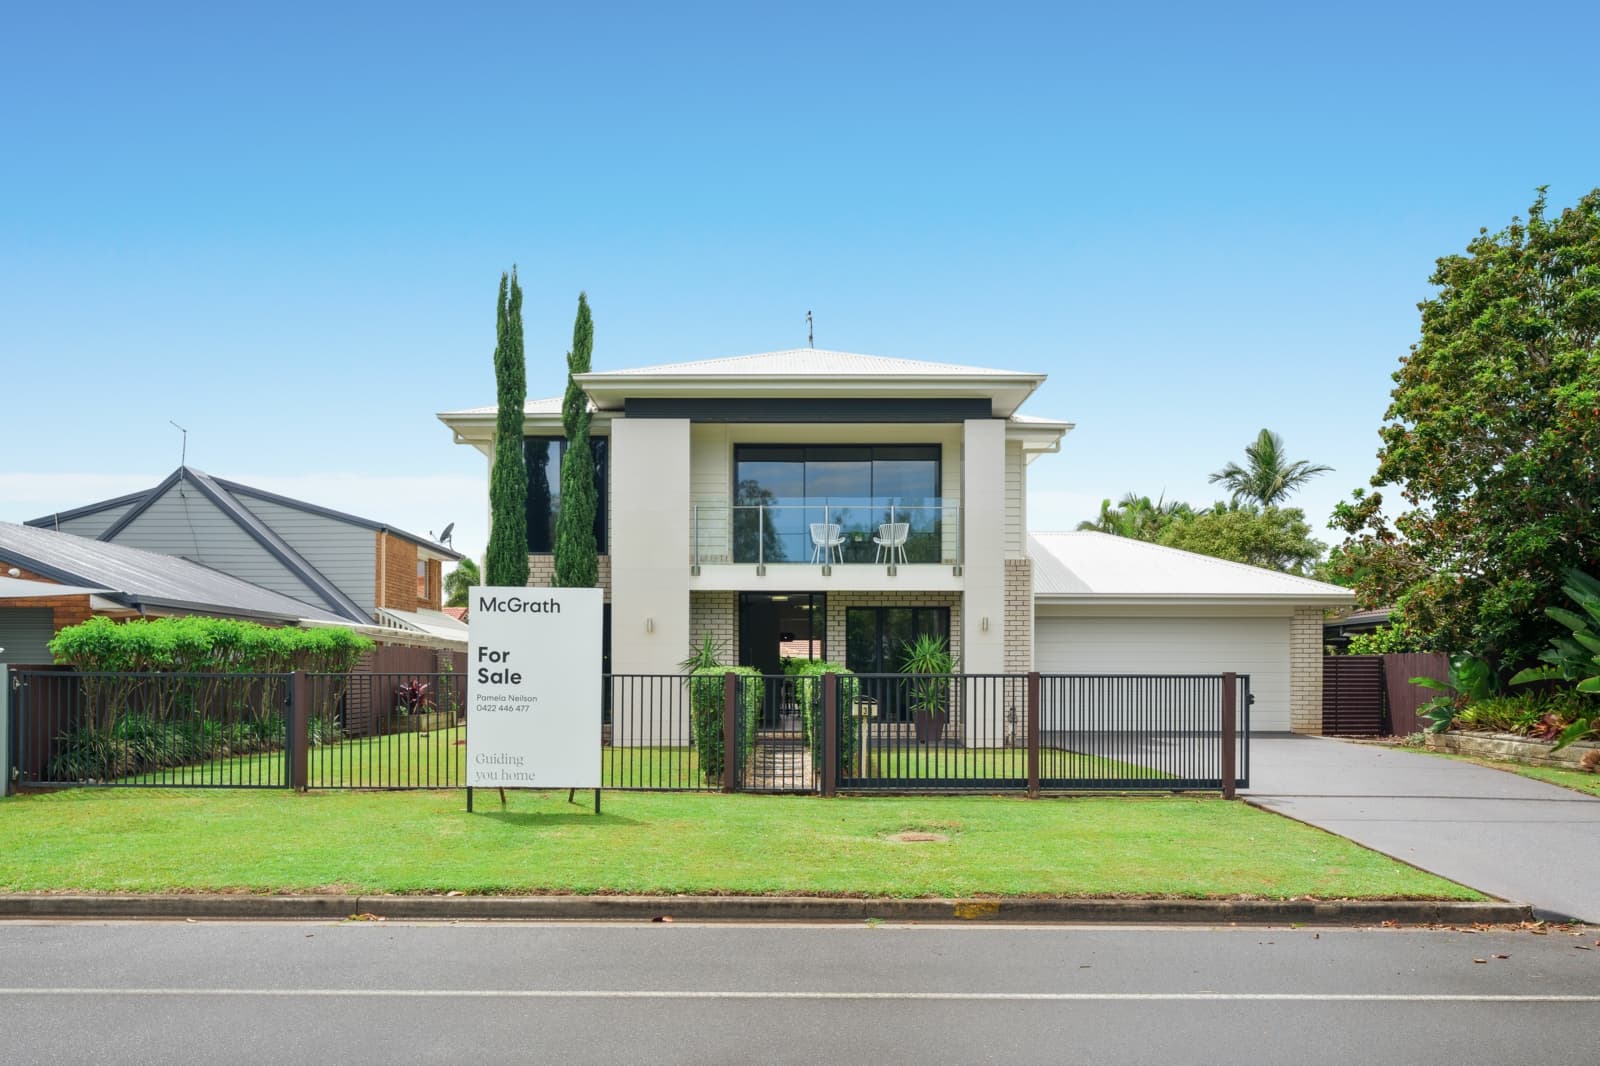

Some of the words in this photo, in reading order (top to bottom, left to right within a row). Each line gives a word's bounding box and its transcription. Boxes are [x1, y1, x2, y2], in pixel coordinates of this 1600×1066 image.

[480, 597, 561, 614] McGrath
[478, 646, 511, 664] For
[477, 667, 522, 686] Sale
[476, 694, 506, 702] Pamela
[508, 695, 538, 703] Neilson
[476, 704, 497, 712] 0422
[498, 704, 514, 713] 446
[514, 704, 530, 713] 477
[475, 752, 524, 768] Guiding
[475, 770, 498, 783] you
[501, 768, 536, 781] home
